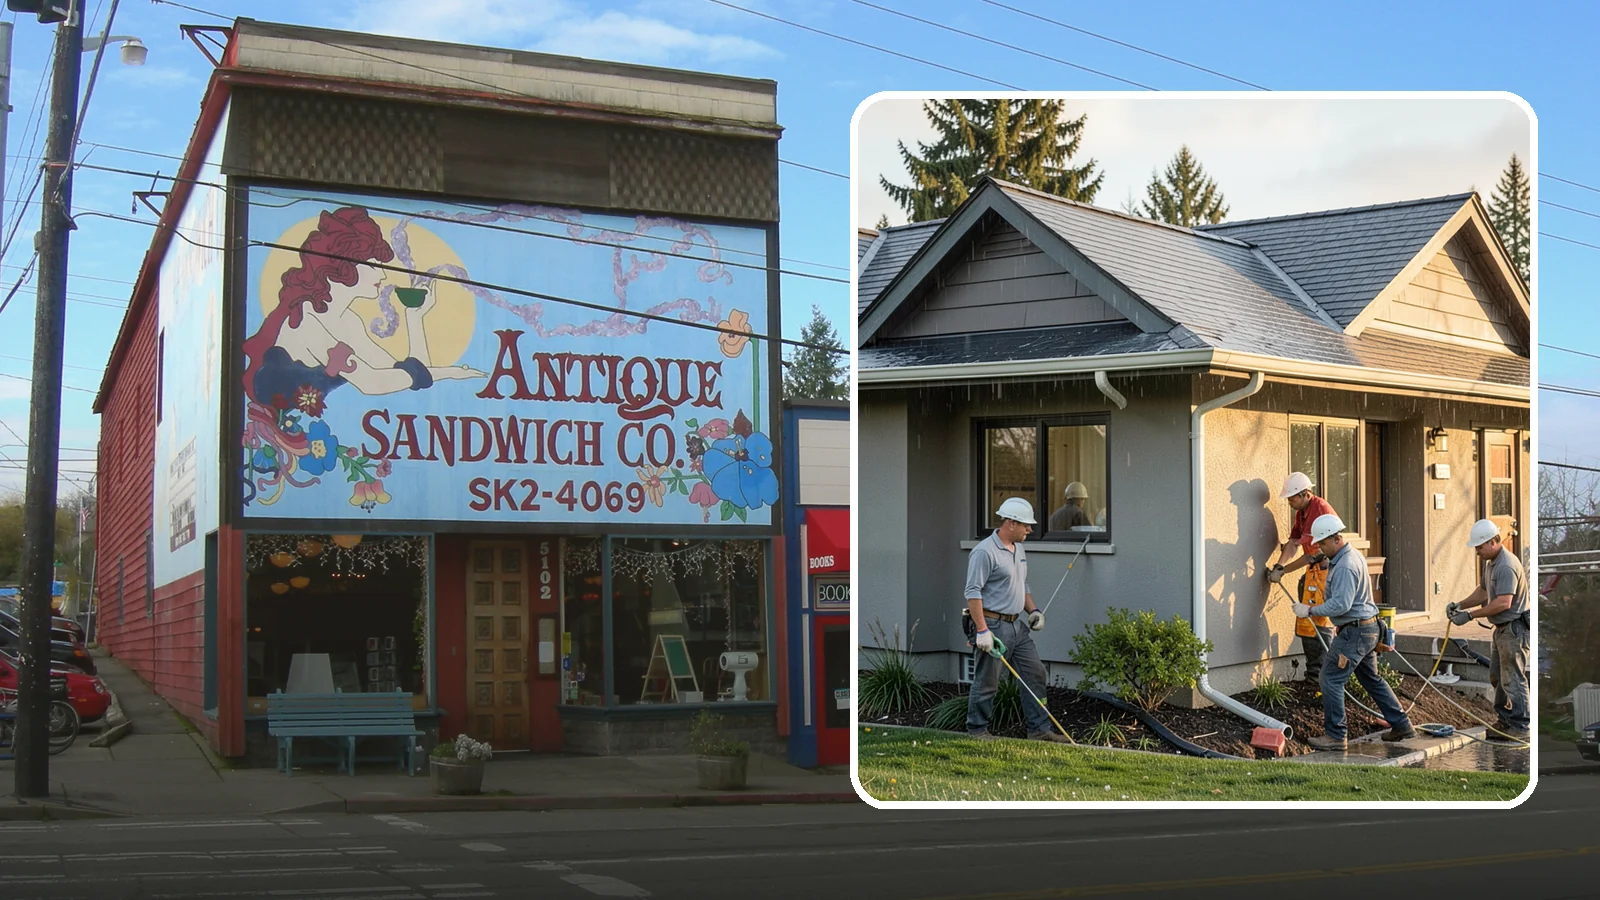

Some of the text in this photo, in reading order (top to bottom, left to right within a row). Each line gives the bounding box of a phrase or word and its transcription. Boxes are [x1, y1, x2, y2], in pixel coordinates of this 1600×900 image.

[475, 328, 723, 421] ANTIQUE
[360, 408, 685, 469] SANDWICH CO.
[467, 476, 646, 513] SK2-4069
[540, 541, 552, 600] 5102
[809, 555, 835, 569] BOOKS
